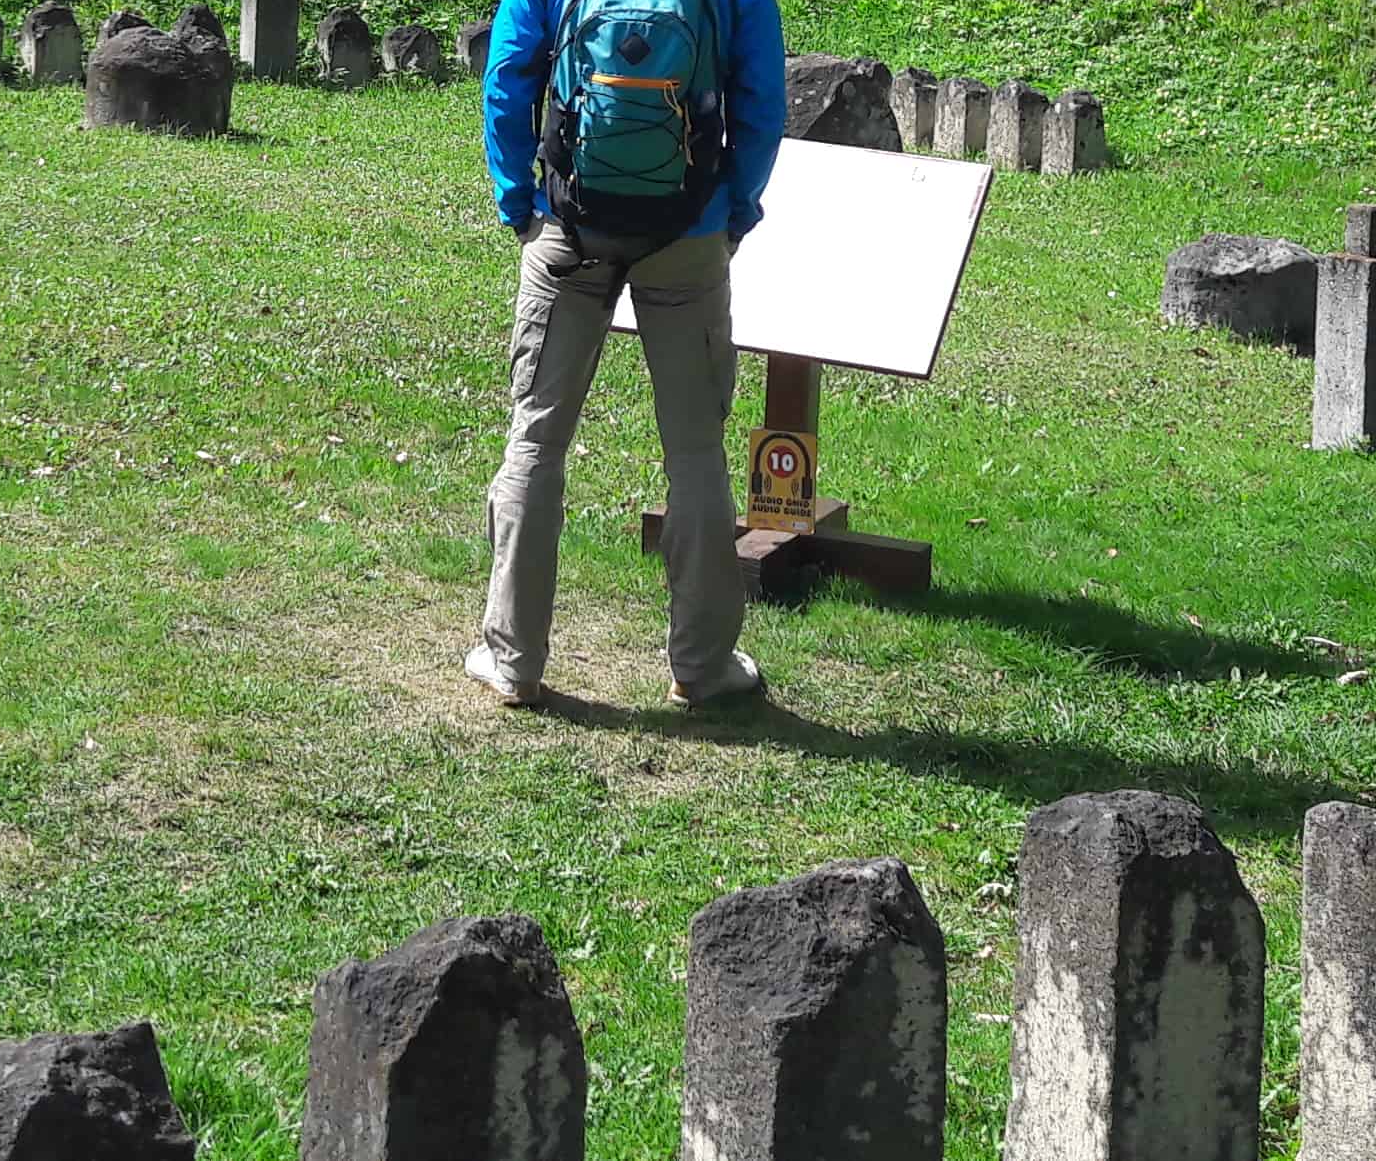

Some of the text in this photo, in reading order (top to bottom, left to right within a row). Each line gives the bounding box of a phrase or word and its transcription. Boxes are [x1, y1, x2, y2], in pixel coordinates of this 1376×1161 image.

[771, 452, 794, 471] 10
[752, 495, 783, 505] AUDIO
[751, 504, 812, 517] AUDIO GUIDE
